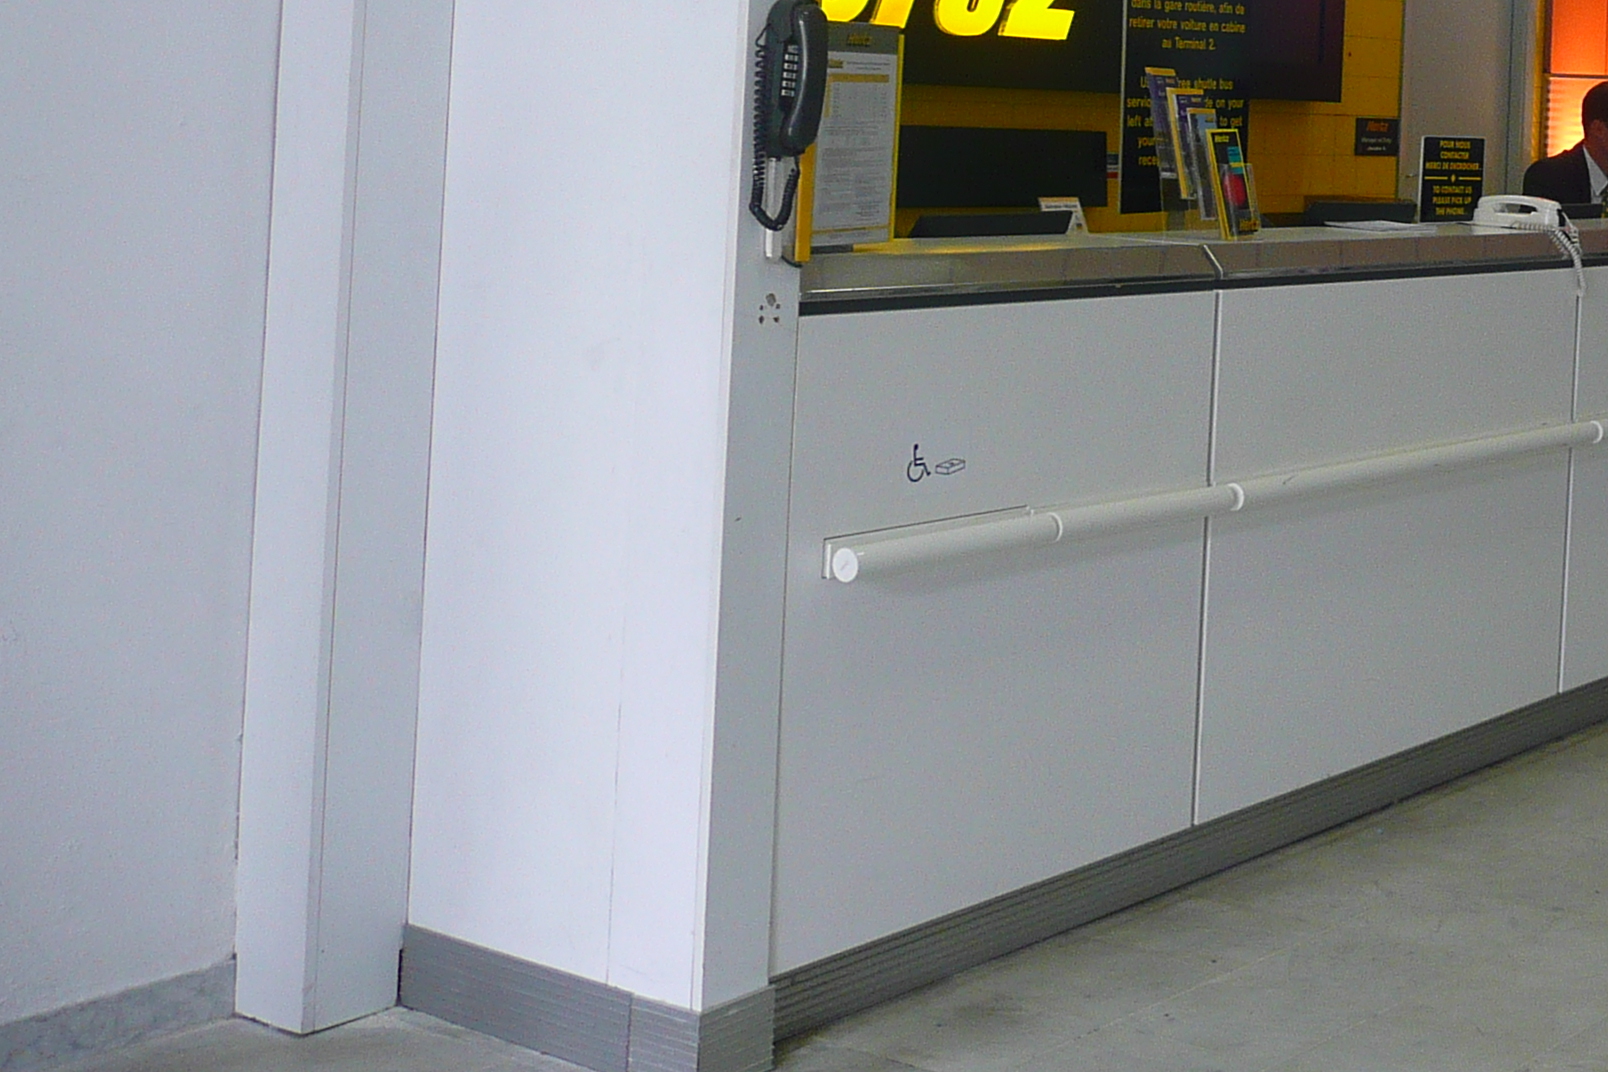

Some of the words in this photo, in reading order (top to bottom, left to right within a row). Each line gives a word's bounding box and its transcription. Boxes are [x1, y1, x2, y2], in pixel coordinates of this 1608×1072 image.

[1164, 0, 1182, 13] gare
[1218, 2, 1233, 14] afin
[1234, 4, 1246, 16] de
[1129, 16, 1155, 28] retirer
[1157, 18, 1178, 30] votre
[1181, 19, 1207, 32] voiture
[1209, 22, 1219, 33] en
[1221, 22, 1246, 34] cabine
[1161, 38, 1173, 49] au
[1174, 35, 1206, 50] Terminal
[1176, 78, 1191, 89] ree
[1194, 77, 1217, 90] shuttle
[1219, 78, 1234, 90] bus
[1126, 96, 1152, 109] servic
[1215, 99, 1226, 108] on
[1228, 99, 1245, 111] your
[1127, 114, 1141, 127] left
[1219, 116, 1229, 127] to
[1230, 116, 1244, 129] get
[1440, 140, 1455, 148] POUR
[1455, 141, 1471, 149] NOUS
[1440, 151, 1470, 159] CONTACTER
[1425, 161, 1441, 169] MERCI
[1433, 185, 1440, 193] TO
[1465, 186, 1473, 194] US
[1432, 196, 1451, 204] PLEASE
[1451, 196, 1463, 204] PICK
[1464, 196, 1472, 204] UP
[1435, 207, 1445, 215] THE
